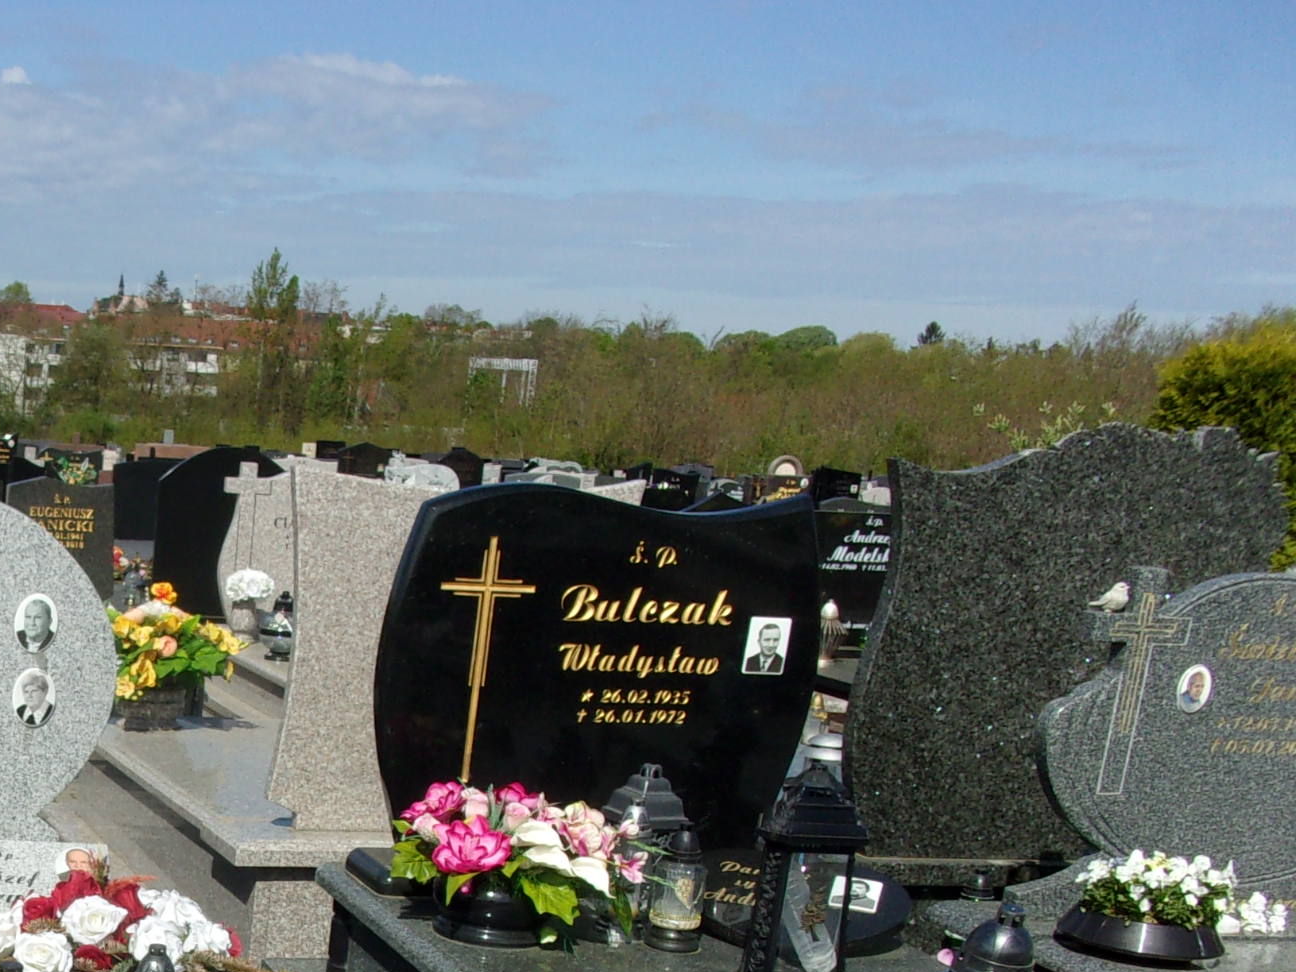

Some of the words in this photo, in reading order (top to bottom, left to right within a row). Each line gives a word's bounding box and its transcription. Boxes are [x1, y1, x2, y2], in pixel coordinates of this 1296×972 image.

[29, 506, 95, 520] EUGENIUSZ
[37, 518, 95, 533] ANICKI
[561, 584, 734, 626] Bulczak
[558, 642, 720, 679] Władysław
[599, 688, 692, 705] 26.02.1935
[593, 708, 688, 725] 26.01.1972
